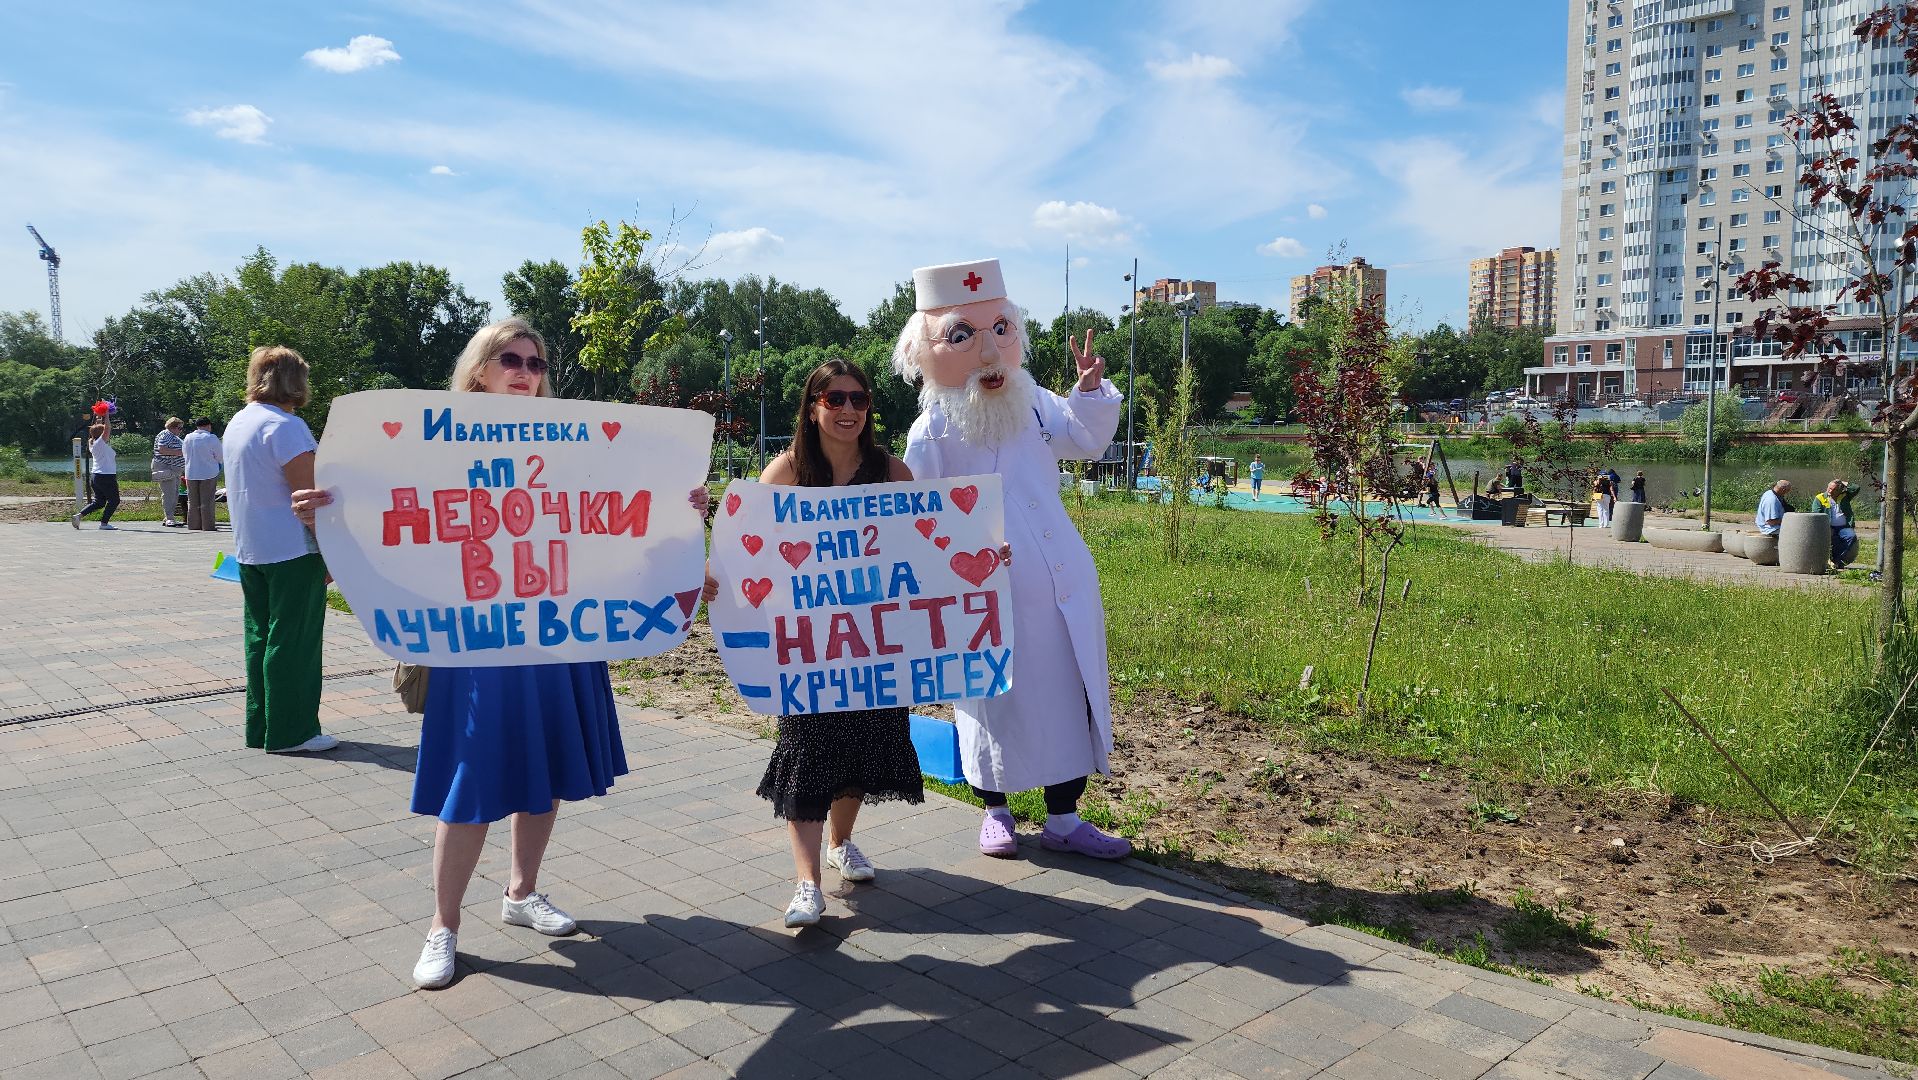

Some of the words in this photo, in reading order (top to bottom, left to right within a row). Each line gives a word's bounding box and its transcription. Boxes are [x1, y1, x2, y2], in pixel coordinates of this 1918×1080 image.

[526, 454, 548, 489] 2
[382, 487, 652, 546] ДЕВОЧКИ
[862, 524, 881, 556] 2
[461, 539, 569, 601] ВЫ
[791, 561, 920, 609] НАША
[374, 601, 526, 653] ЛУЧШЕ
[538, 587, 702, 647] ВСЕХ!
[775, 590, 1002, 665] НАСТЯ
[779, 662, 898, 715] КРУЧЕ
[910, 647, 1012, 703] ВСЕХ
